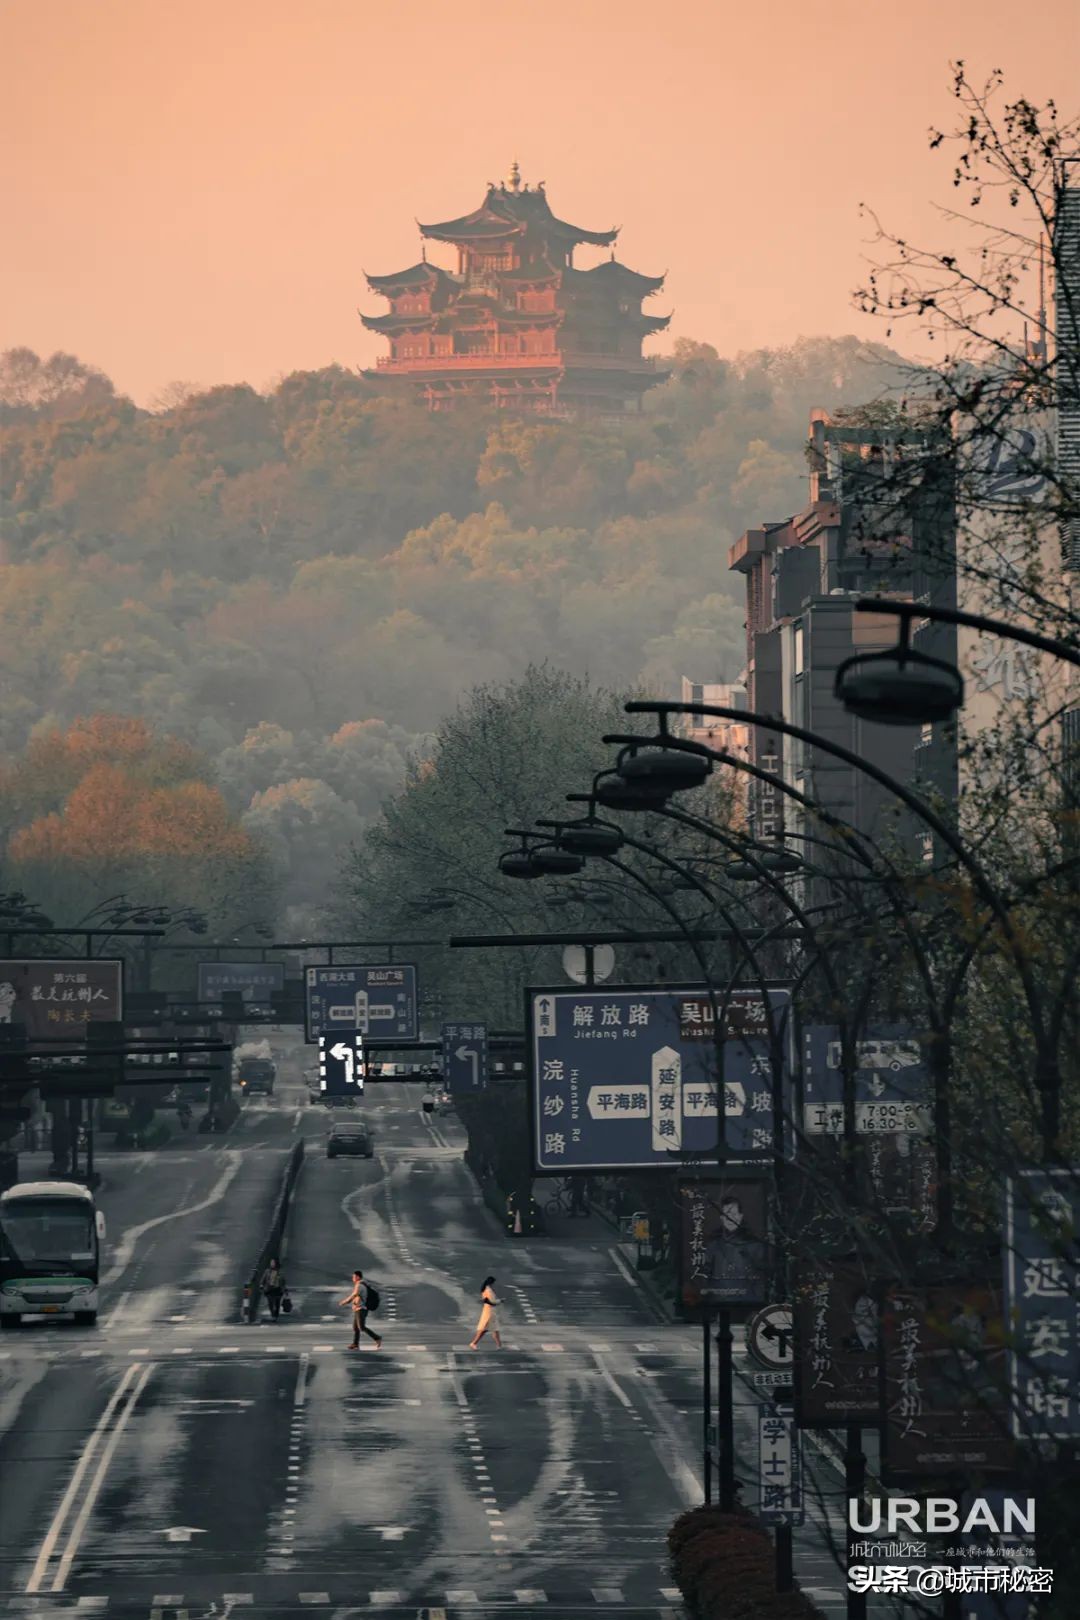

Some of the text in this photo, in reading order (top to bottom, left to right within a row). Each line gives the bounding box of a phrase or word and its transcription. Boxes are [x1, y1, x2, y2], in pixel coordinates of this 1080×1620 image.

[573, 1004, 650, 1027] 解放路
[680, 1001, 766, 1023] 吴山广场
[444, 1026, 486, 1040] 平海路
[574, 1028, 637, 1041] Jiefang Rd
[543, 1060, 565, 1154] 浣纱路
[570, 1069, 582, 1142] Huansha Rd
[597, 1093, 648, 1111] 平海路
[659, 1068, 676, 1137] 延安路
[687, 1091, 738, 1110] 平海路
[763, 1420, 787, 1509] 学士路
